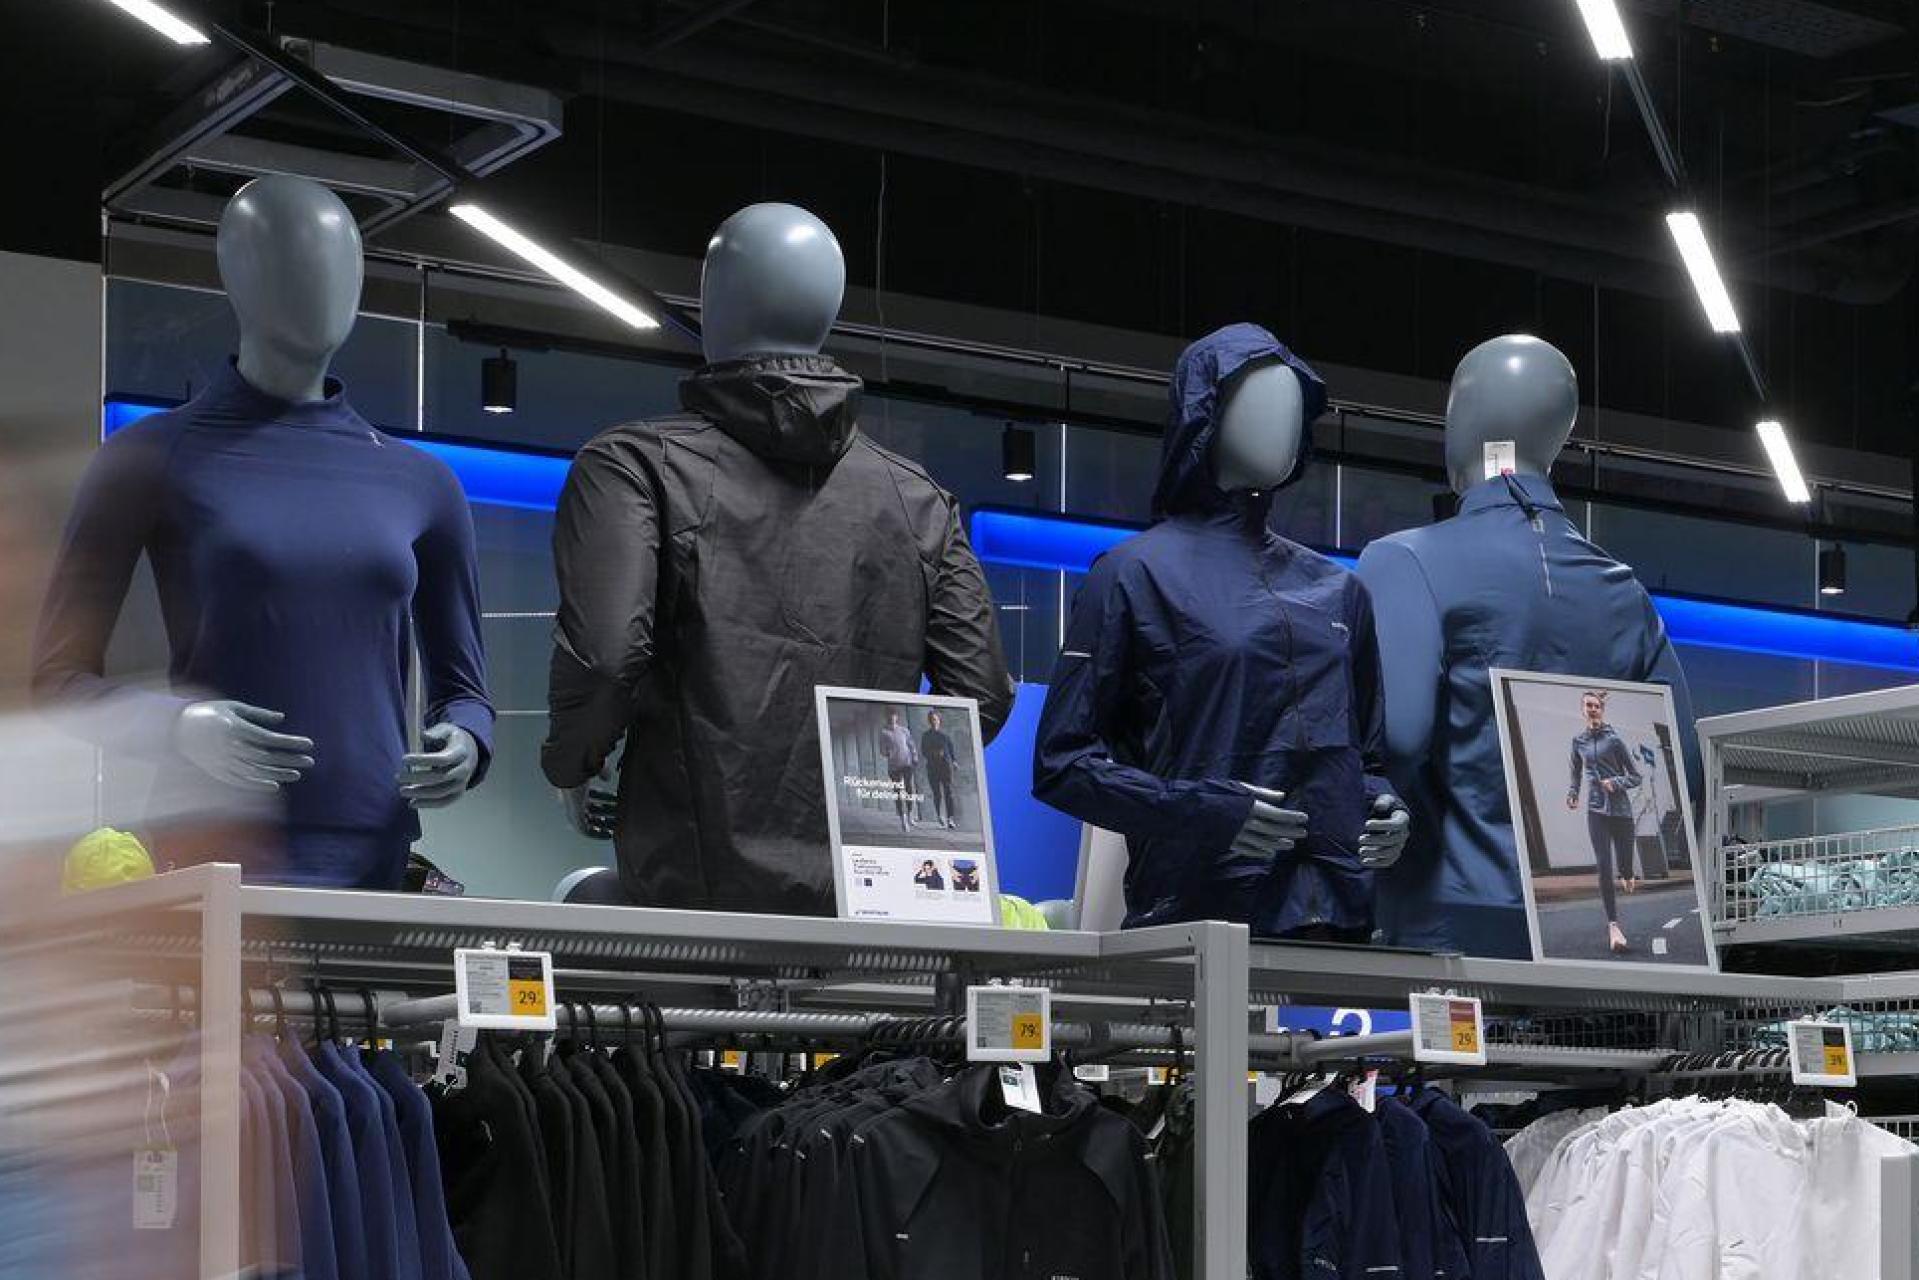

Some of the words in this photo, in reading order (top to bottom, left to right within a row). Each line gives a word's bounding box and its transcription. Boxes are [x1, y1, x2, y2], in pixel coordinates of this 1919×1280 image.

[843, 775, 905, 789] Rückenwind
[856, 788, 871, 799] für
[871, 789, 898, 799] deine
